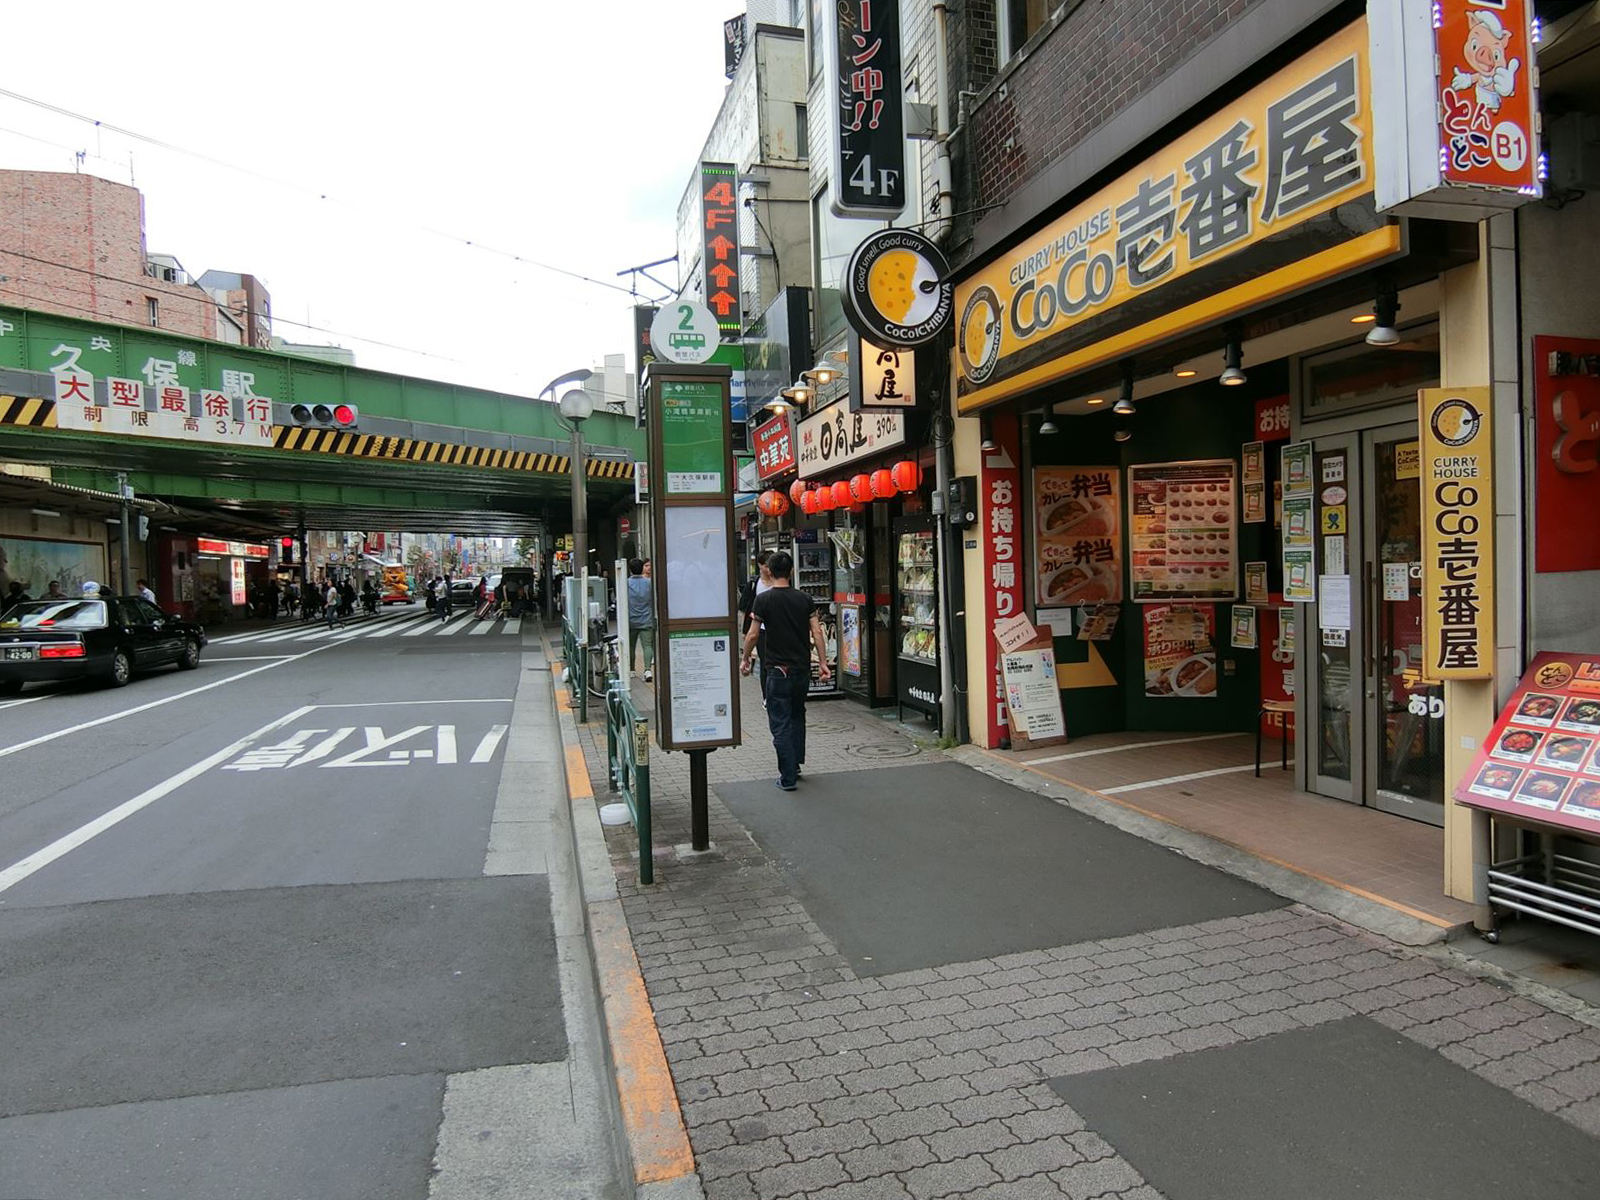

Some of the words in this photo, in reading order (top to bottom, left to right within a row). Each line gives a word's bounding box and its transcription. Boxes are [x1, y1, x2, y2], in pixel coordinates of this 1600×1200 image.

[1443, 88, 1491, 135] とん
[1496, 133, 1523, 161] B1
[849, 154, 899, 197] 4F
[704, 183, 735, 229] 4F
[857, 268, 866, 293] Good
[878, 235, 900, 250] Good
[902, 238, 924, 251] curry
[1009, 246, 1052, 286] CURRY
[1054, 206, 1112, 261] HOUSE
[677, 304, 694, 330] 2
[884, 282, 951, 339] CoCoICHIBANYA
[59, 375, 271, 422] 大型最徐行
[760, 434, 789, 471] 中華苑
[820, 408, 867, 461] 日高屋
[1433, 456, 1477, 468] CURRY
[1433, 467, 1478, 479] HOUSE
[1071, 472, 1112, 499] 弁当
[991, 480, 1015, 616] お持ち帰り
[1072, 538, 1114, 565] 弁当
[1408, 693, 1444, 718] あり
